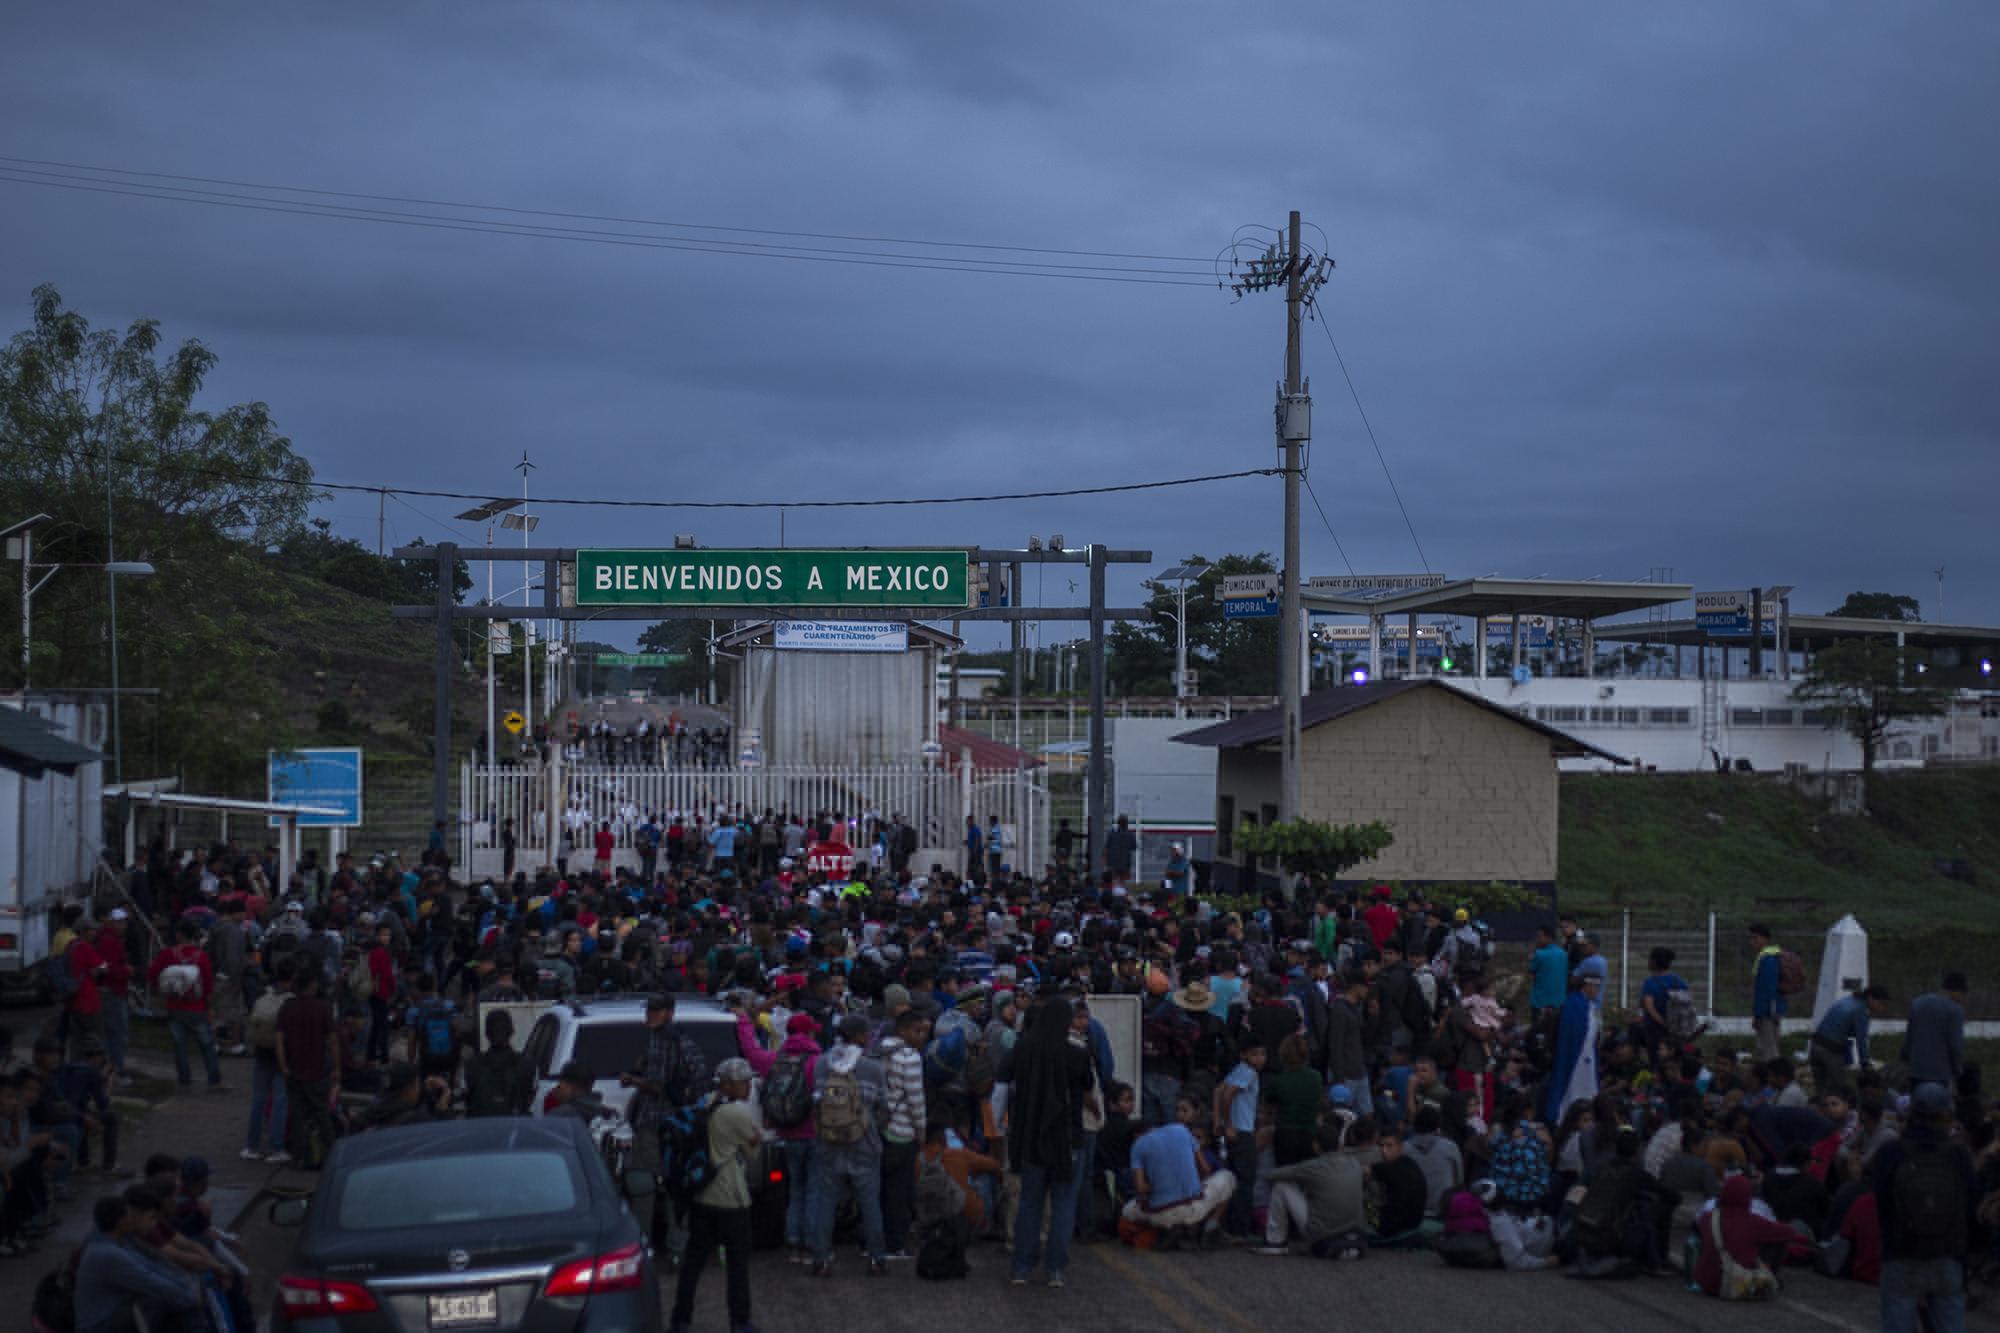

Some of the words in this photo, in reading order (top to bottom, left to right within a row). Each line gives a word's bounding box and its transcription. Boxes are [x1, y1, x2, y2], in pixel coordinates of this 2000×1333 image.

[595, 565, 783, 591] BIENVENIDOS
[807, 565, 824, 590] A
[847, 565, 949, 591] MEXICO
[1225, 579, 1266, 592] FUMIGACION
[1225, 601, 1267, 614] TEMPORAL
[1696, 596, 1736, 607] MODULO
[1697, 615, 1737, 625] MIGRACION
